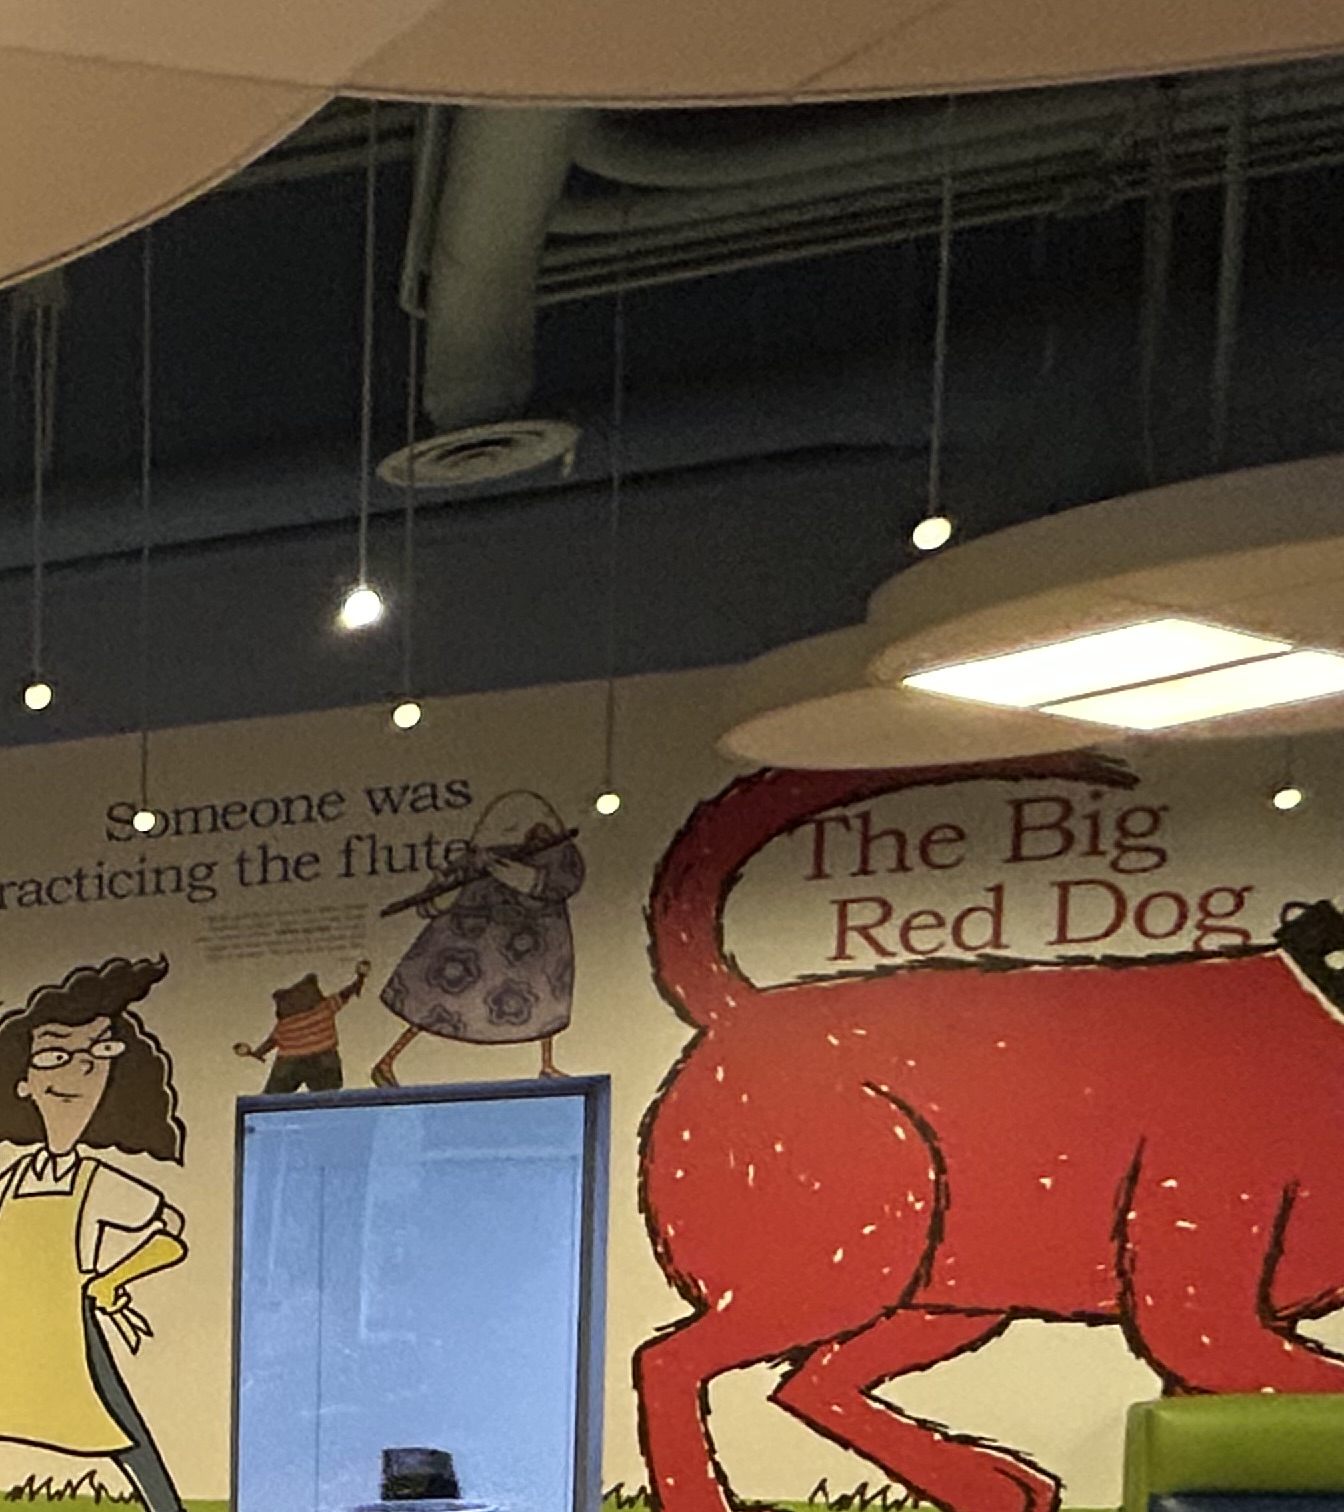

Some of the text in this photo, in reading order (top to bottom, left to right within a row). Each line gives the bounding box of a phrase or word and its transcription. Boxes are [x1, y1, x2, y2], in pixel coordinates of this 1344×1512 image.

[106, 778, 474, 843] Someone was
[788, 791, 1170, 881] The Big
[236, 840, 321, 887] the
[828, 878, 1257, 961] Red Dog
